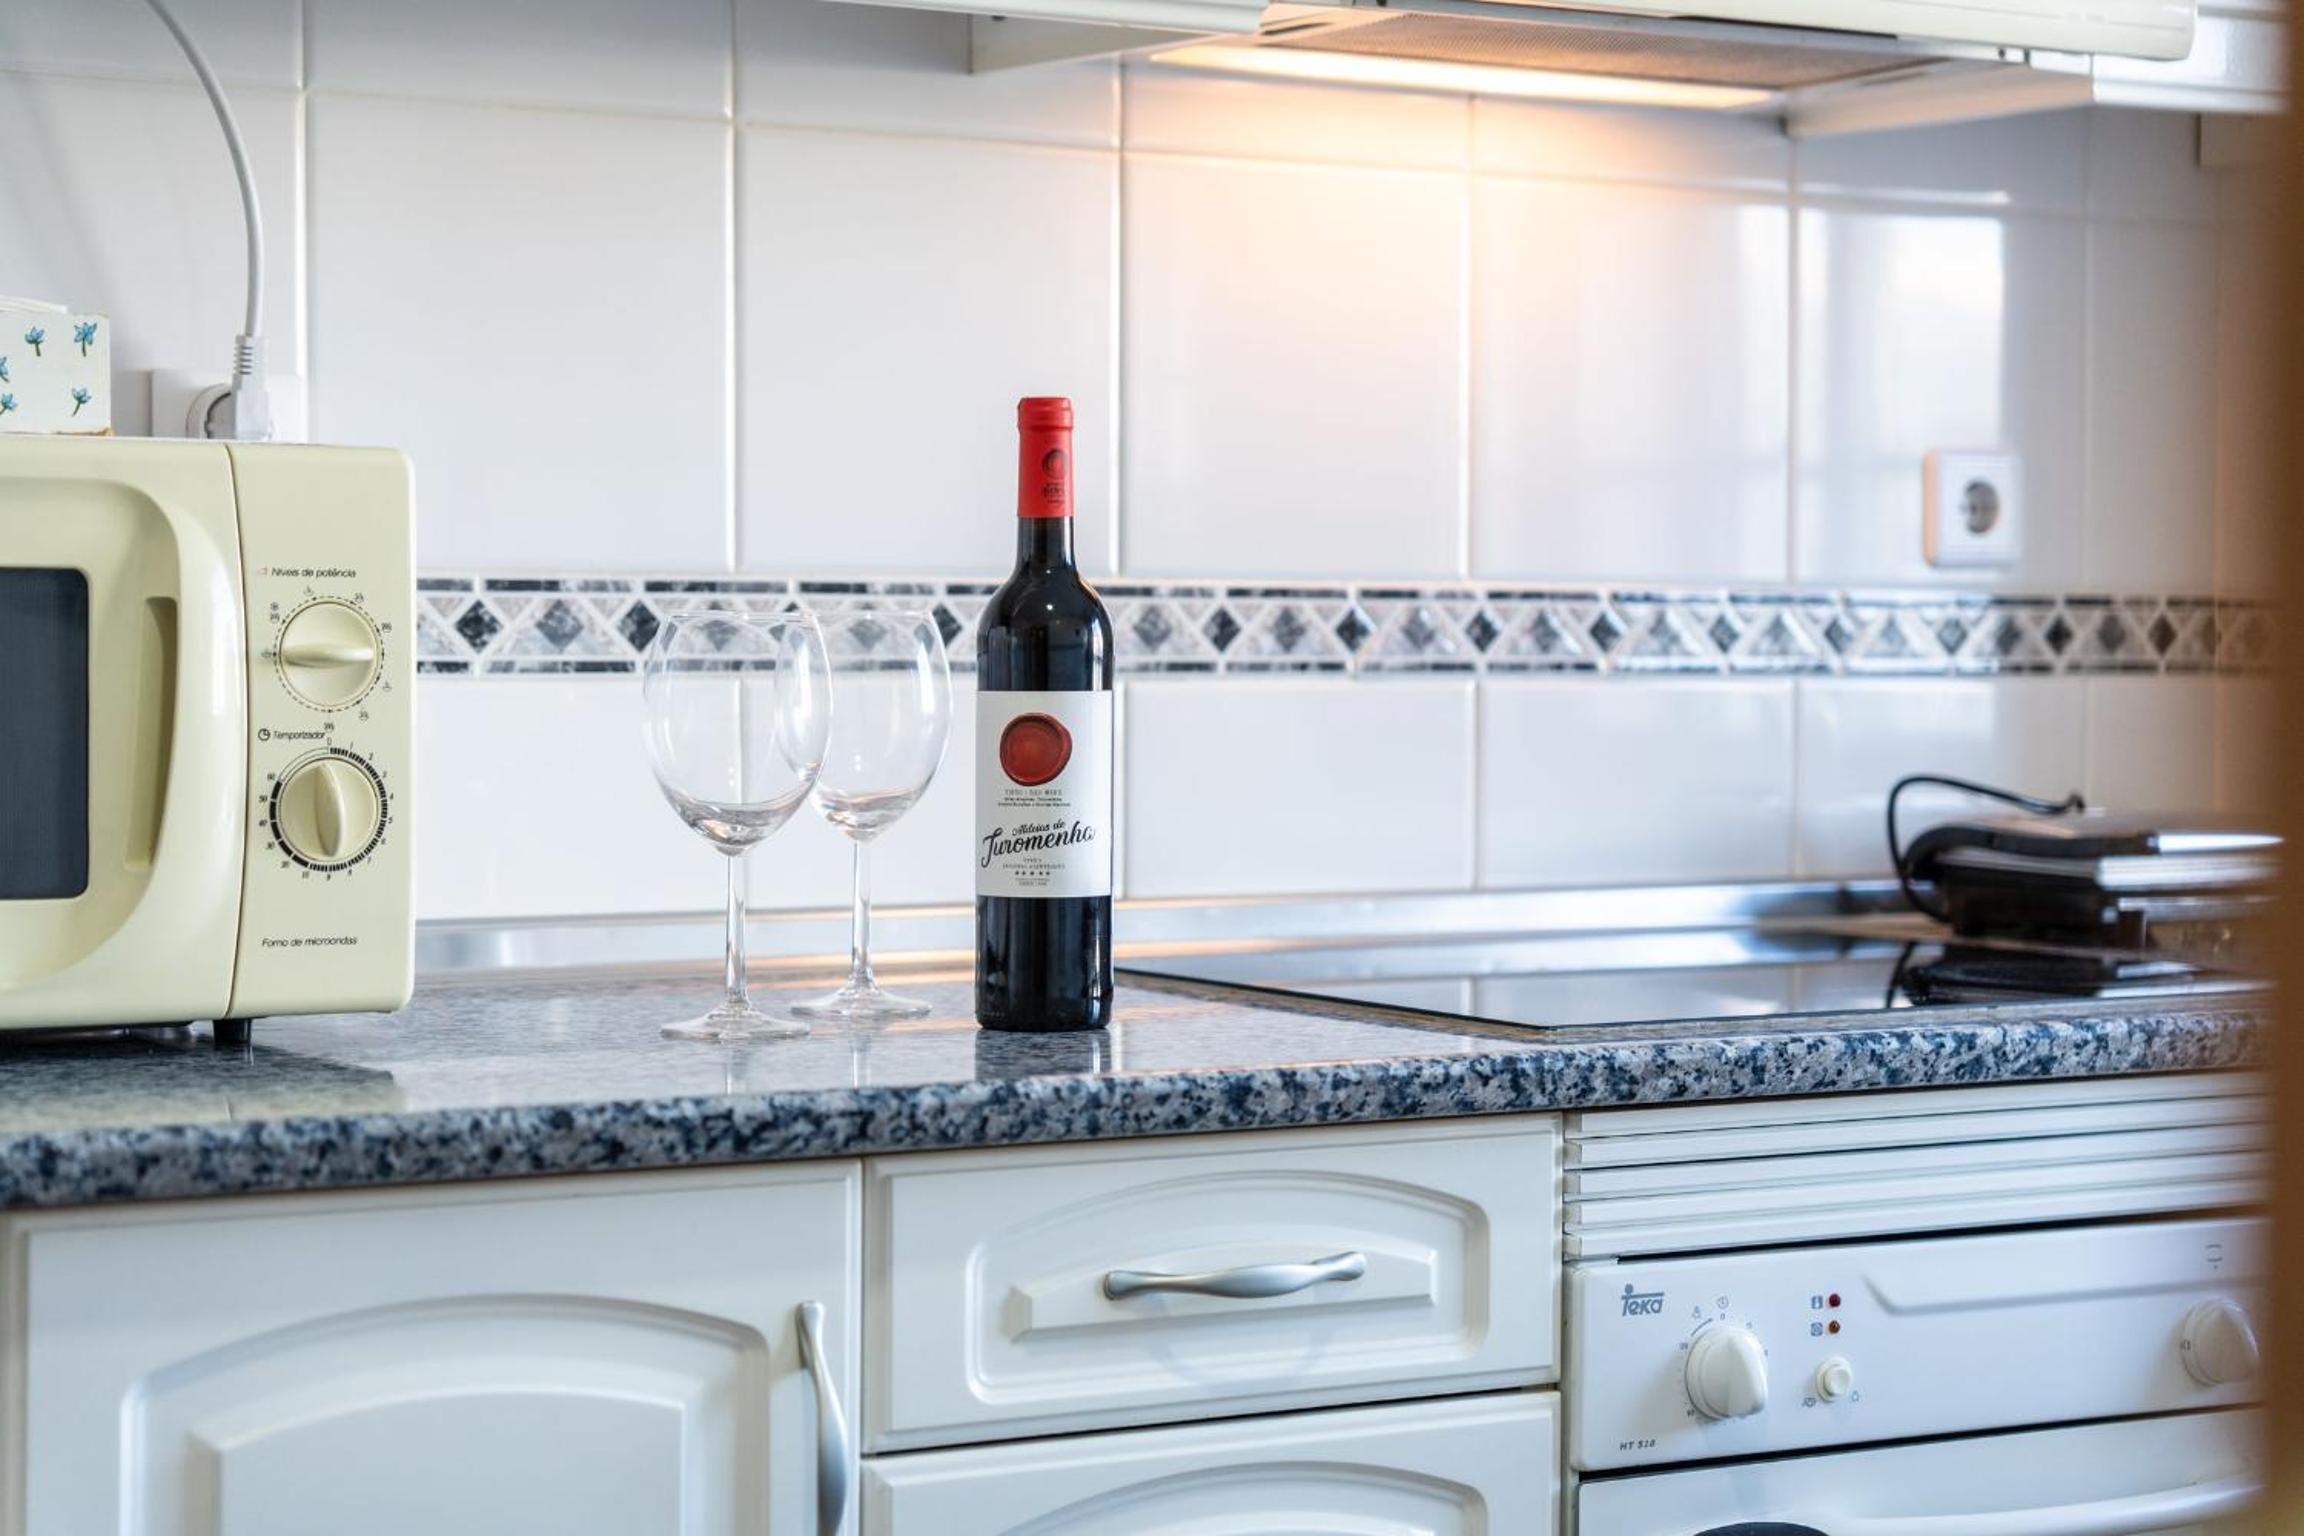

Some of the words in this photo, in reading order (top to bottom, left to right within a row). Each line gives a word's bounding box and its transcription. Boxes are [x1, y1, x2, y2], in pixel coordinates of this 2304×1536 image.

[301, 568, 314, 577] de
[316, 568, 356, 578] potência
[273, 731, 325, 742] Temporizador
[1053, 818, 1065, 830] de
[290, 938, 303, 947] de
[304, 936, 357, 946] microondas
[1620, 1441, 1634, 1451] HT
